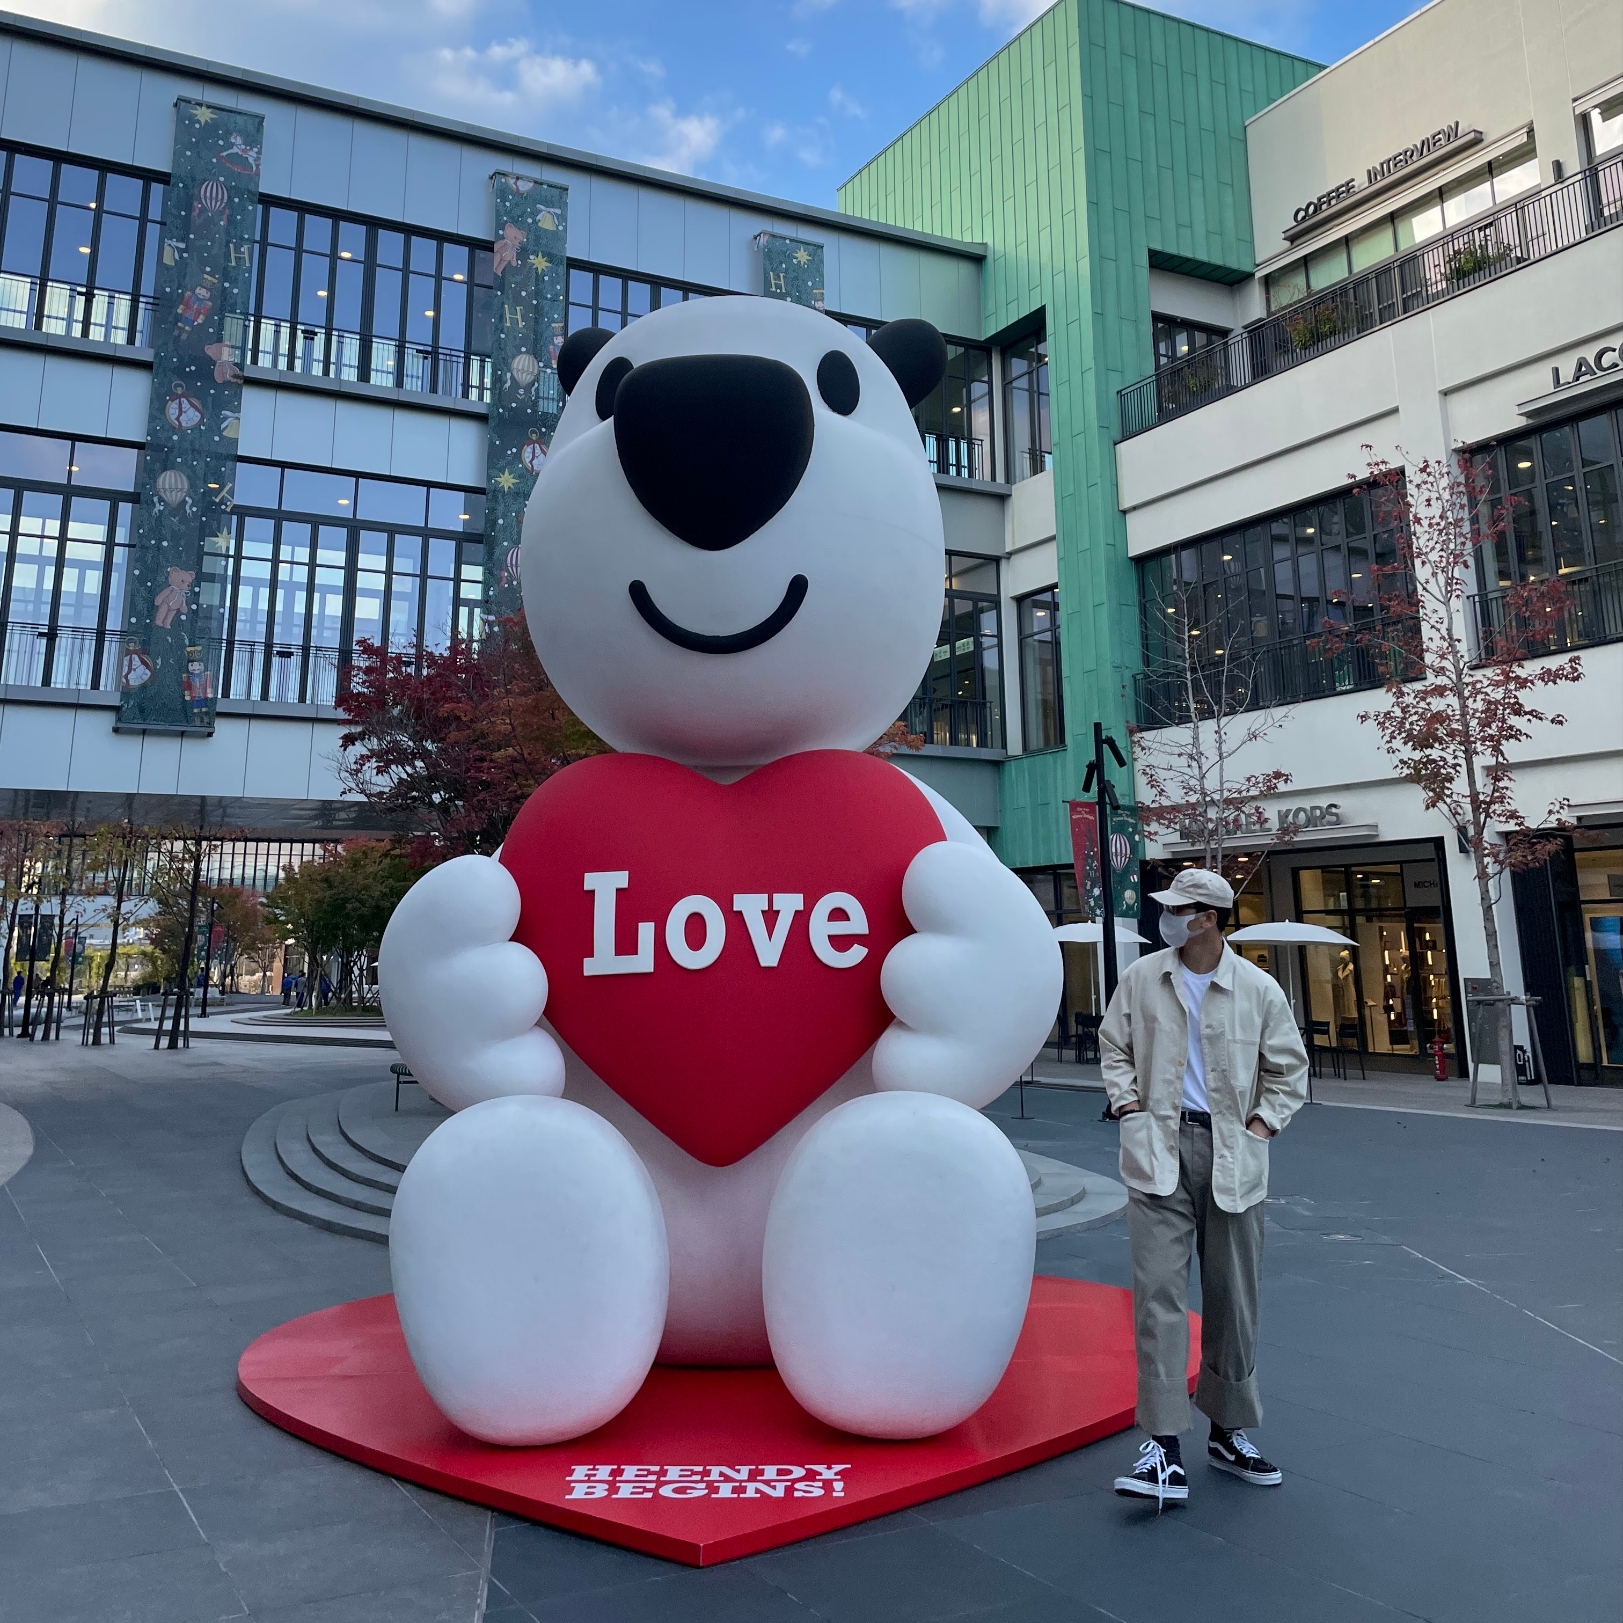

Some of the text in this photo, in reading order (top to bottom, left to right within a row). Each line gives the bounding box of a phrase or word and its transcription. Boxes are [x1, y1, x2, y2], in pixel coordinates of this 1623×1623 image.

[1293, 120, 1460, 224] COFFEE INTERVIEW
[1551, 341, 1623, 390] LAC
[1277, 803, 1342, 830] KORS
[583, 870, 870, 977] Love
[564, 1481, 845, 1499] BEGINS!
[565, 1464, 852, 1481] HEENDY
